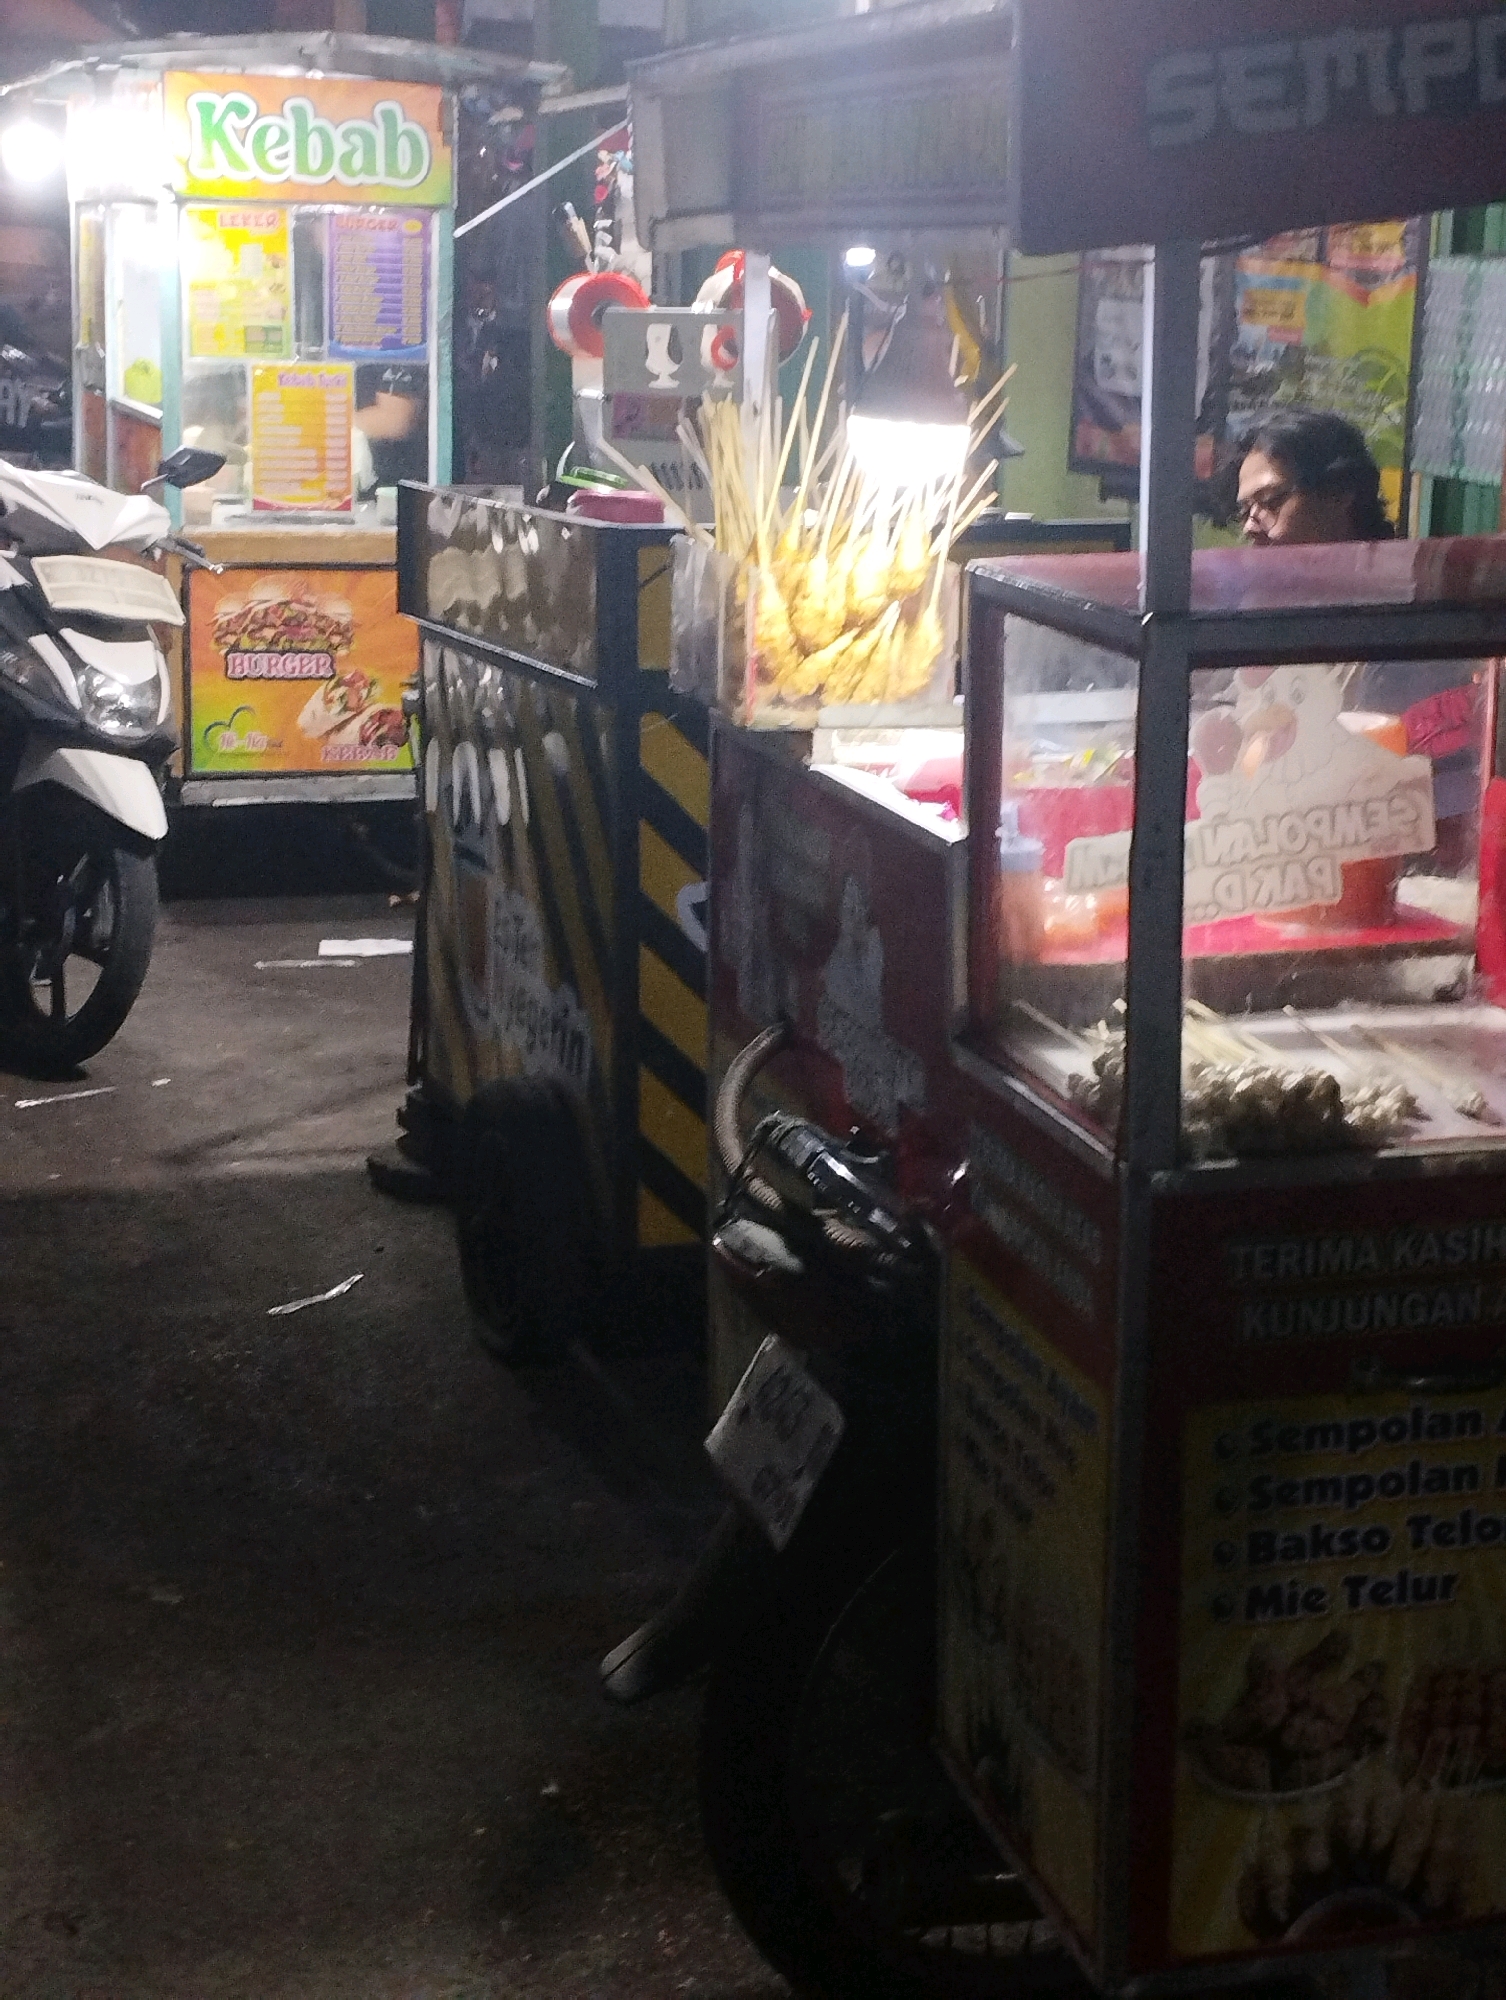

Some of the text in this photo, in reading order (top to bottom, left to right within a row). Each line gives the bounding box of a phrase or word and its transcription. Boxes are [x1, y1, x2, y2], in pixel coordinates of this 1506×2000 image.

[190, 94, 431, 186] Kebab
[228, 652, 334, 679] BURGER
[1231, 1238, 1380, 1280] TERIMA
[1242, 1286, 1482, 1340] KUNJUNGAN
[1249, 1404, 1484, 1454] Sempolan
[1248, 1457, 1482, 1511] Sempolan
[1246, 1508, 1506, 1568] Bakso Telo
[1245, 1569, 1459, 1621] Mie Telur
